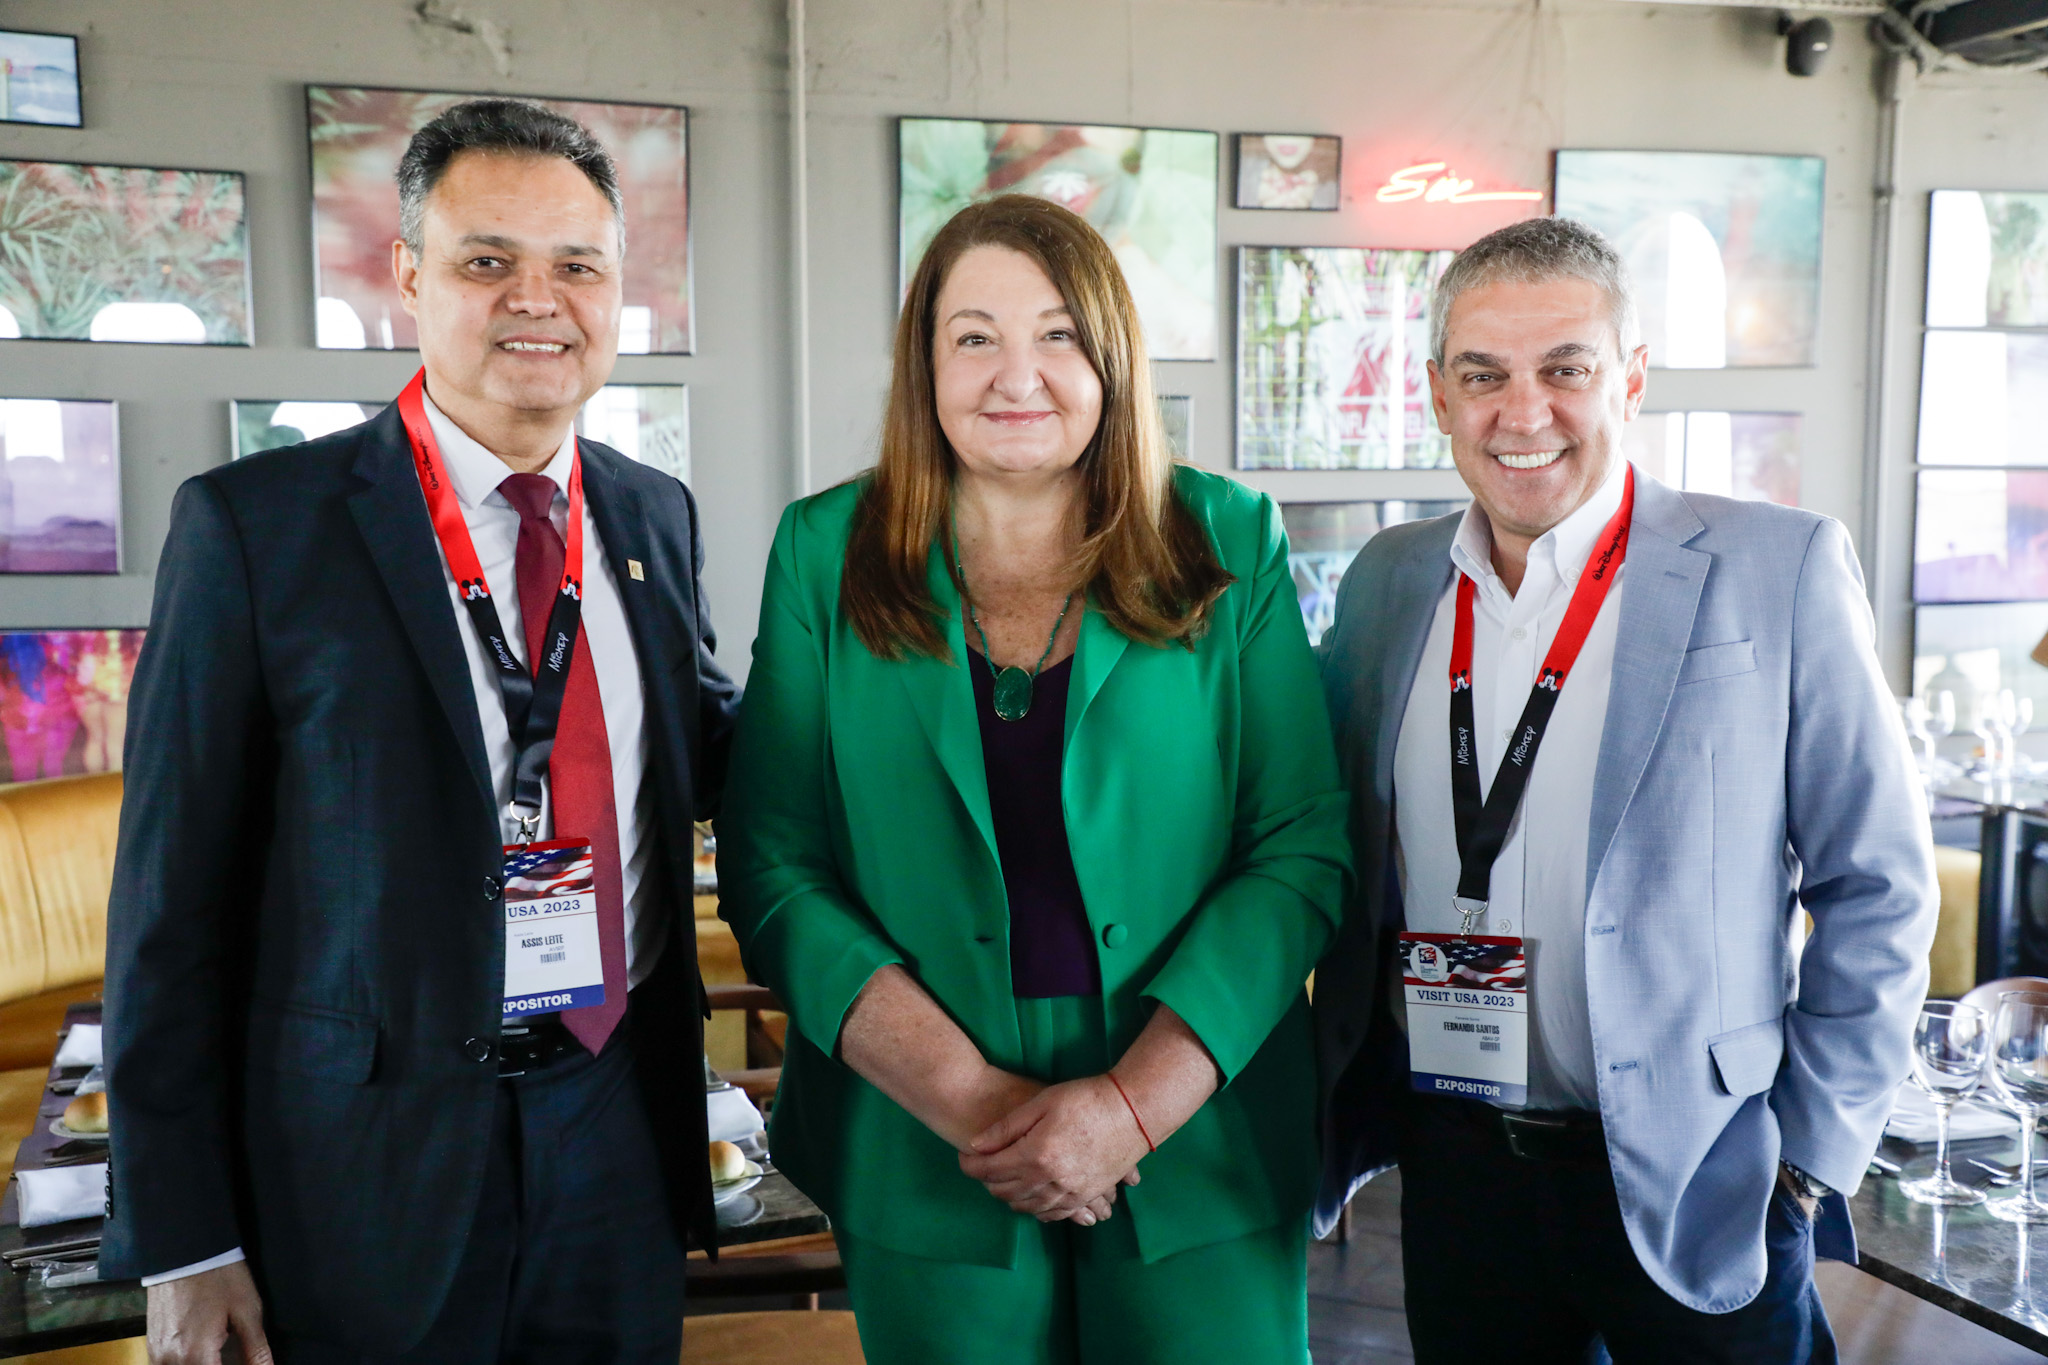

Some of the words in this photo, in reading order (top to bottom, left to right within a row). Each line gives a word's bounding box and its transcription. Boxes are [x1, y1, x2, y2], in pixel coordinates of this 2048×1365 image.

[507, 905, 538, 918] USA
[543, 899, 581, 914] 2023
[521, 936, 544, 949] ASSIS
[544, 933, 564, 946] LEITE
[503, 993, 573, 1013] POSITOR
[1416, 989, 1450, 1002] VISIT
[1454, 992, 1480, 1005] USA
[1483, 995, 1515, 1007] 2023
[1443, 1021, 1475, 1033] FERNANDO
[1475, 1023, 1500, 1035] SANTOS
[1435, 1078, 1501, 1097] EXPOSITOR
